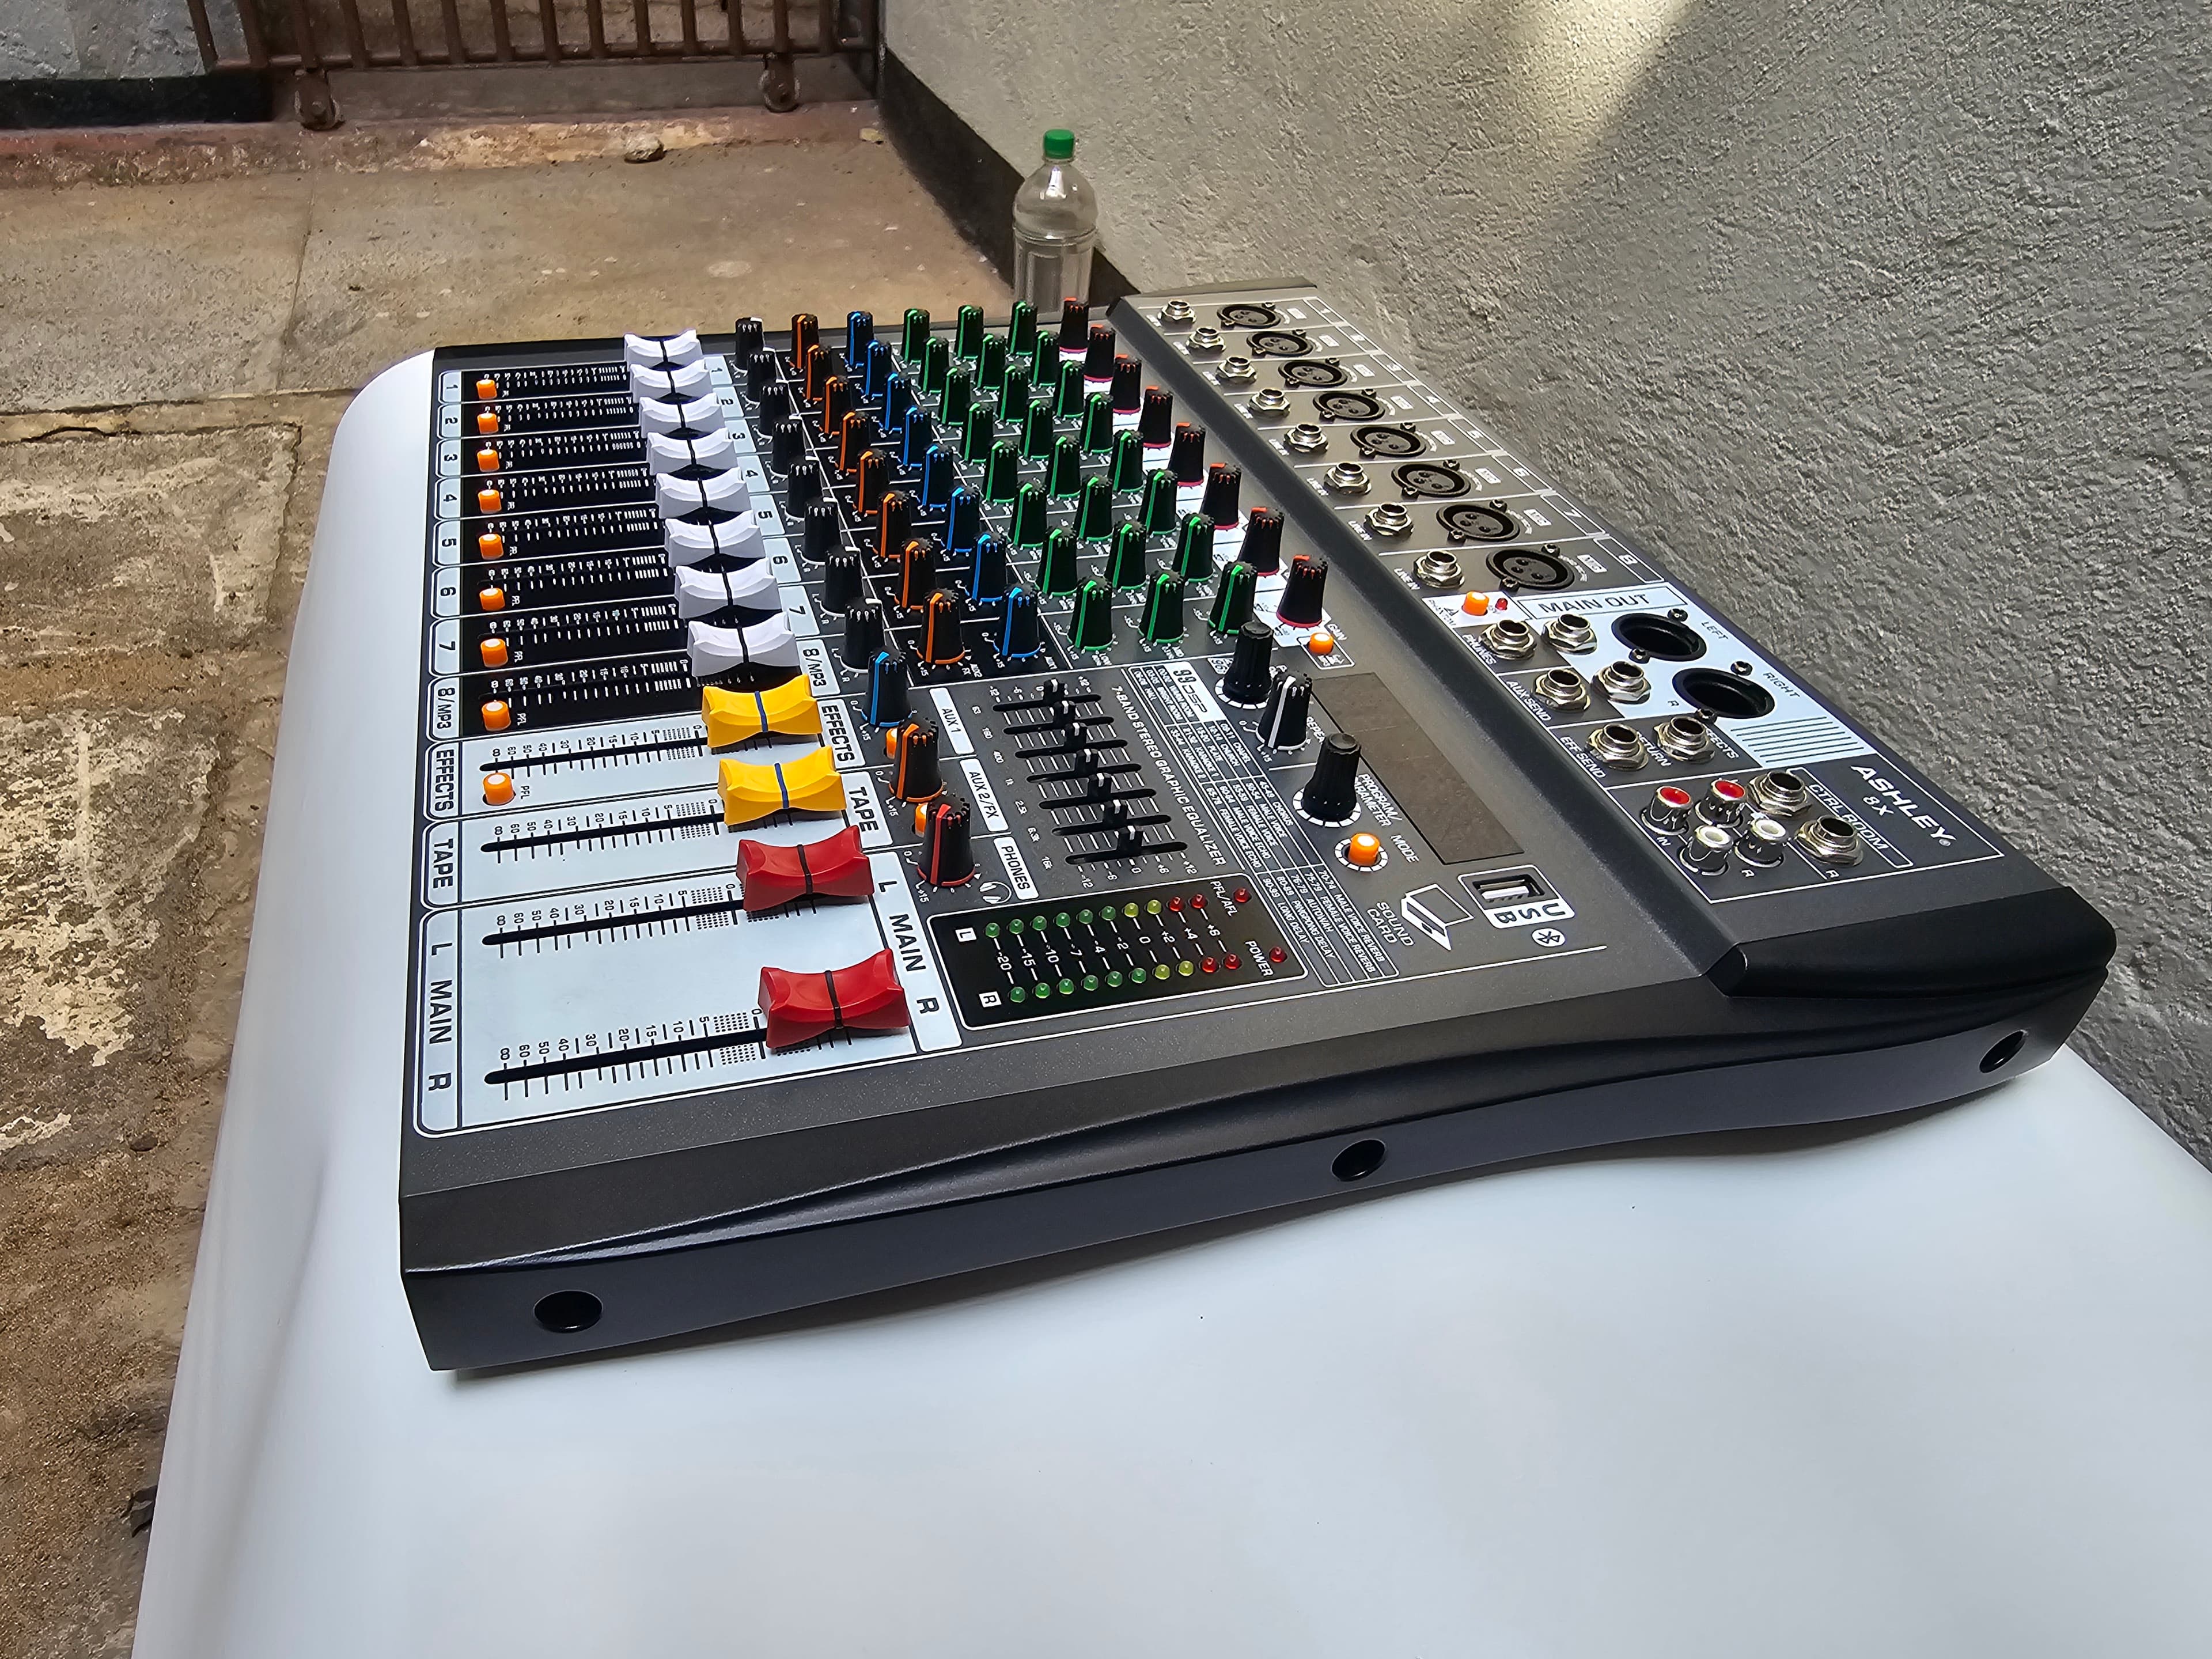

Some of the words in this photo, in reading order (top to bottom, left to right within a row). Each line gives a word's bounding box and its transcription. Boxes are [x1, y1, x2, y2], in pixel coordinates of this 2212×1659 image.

[444, 454, 457, 462] 3
[443, 494, 457, 502] 4
[442, 539, 456, 547] 5
[440, 587, 456, 596] 6
[789, 606, 806, 615] 7
[1538, 599, 1602, 613] MAIN
[1605, 594, 1649, 606] OUT
[1702, 622, 1728, 640] LEFT
[439, 641, 455, 650] 7
[804, 649, 826, 687] 8/MP3
[1763, 672, 1800, 698] RIGHT
[1507, 681, 1528, 698] AUX
[1524, 696, 1551, 721] SEND
[437, 688, 455, 729] 8/MP3
[942, 709, 959, 726] AUX
[821, 705, 855, 762] EFFECTS
[1560, 736, 1584, 753] EFF
[1577, 751, 1606, 778] SEND
[435, 749, 454, 811] EFFECTS
[1112, 685, 1139, 720] 7-BAND
[1132, 721, 1162, 758] STEREO
[1155, 759, 1190, 804] GRAPHIC
[1182, 805, 1226, 866] EQUALIZER
[521, 786, 529, 799] PFL
[969, 772, 986, 791] AUX
[979, 794, 999, 818] 2/FX
[1358, 774, 1403, 820] PROGRAM/
[849, 786, 878, 832] TAPE
[1851, 766, 1957, 839] ASHLEY
[1863, 796, 1894, 816] 8X
[595, 813, 604, 823] 20
[619, 810, 628, 820] 15
[641, 807, 650, 817] 10
[1273, 802, 1294, 825] CHORUS
[1809, 784, 1844, 813] CTRL
[1842, 814, 1889, 849] ROOM
[527, 821, 536, 831] 50
[544, 819, 553, 830] 40
[567, 816, 576, 826] 30
[1247, 805, 1267, 828] FEMALE
[1262, 829, 1278, 846] VOICE
[1259, 804, 1274, 820] MALE
[1271, 821, 1287, 838] VOICE
[510, 824, 520, 834] 60
[1233, 808, 1248, 824] MALE
[1245, 825, 1260, 842] VOICE
[1255, 842, 1271, 859] ECHO
[1219, 809, 1238, 832] FEMALE
[1234, 832, 1252, 850] VOICE
[1245, 851, 1262, 868] ECHO
[1657, 837, 1671, 846] IN
[1391, 835, 1419, 862] MODE
[433, 838, 453, 888] TAPE
[1002, 846, 1030, 890] PHONES
[1158, 865, 1169, 874] +6
[1183, 861, 1198, 874] +12
[1082, 874, 1093, 888] -12
[1107, 871, 1118, 880] -6
[1826, 870, 1839, 878] R
[604, 900, 614, 911] 20
[630, 897, 639, 907] 15
[654, 894, 664, 904] 10
[1210, 881, 1238, 916] PFL/AFL
[532, 911, 541, 921] 50
[549, 908, 560, 918] 40
[574, 904, 584, 914] 30
[1306, 899, 1334, 932] AUTOWAH
[1495, 903, 1566, 923] USB
[514, 912, 524, 923] 60
[1278, 902, 1294, 921] LONG
[1290, 922, 1310, 943] DELAY
[1377, 902, 1415, 946] SOUND
[1184, 927, 1198, 940] +4
[1207, 924, 1221, 936] +6
[1292, 900, 1321, 936] PINGPONG
[1315, 936, 1336, 959] DELAY
[1335, 894, 1351, 912] MALE
[1349, 913, 1366, 933] VOICE
[1362, 933, 1385, 962] REVERB
[1367, 909, 1397, 944] CARD
[1162, 931, 1175, 943] +2
[1320, 896, 1342, 922] FEMALE
[1338, 923, 1356, 944] VOICE
[1352, 944, 1376, 972] REVERB
[431, 942, 452, 956] L
[878, 881, 897, 892] L
[889, 914, 926, 972] MAIN
[917, 997, 940, 1014] R
[1070, 944, 1082, 956] -7
[1094, 941, 1105, 953] -4
[1117, 937, 1128, 950] -2
[1021, 949, 1036, 967] -15
[1046, 944, 1060, 963] -10
[1245, 941, 1273, 976] POWER
[997, 952, 1012, 971] -20
[983, 995, 997, 1003] R
[429, 980, 452, 1044] MAIN
[646, 1025, 657, 1037] 15
[673, 1021, 684, 1033] 10
[585, 1033, 597, 1047] 30
[618, 1028, 630, 1041] 20
[519, 1044, 530, 1057] 60
[539, 1041, 550, 1054] 50
[558, 1039, 569, 1051] 40
[428, 1073, 451, 1090] R
